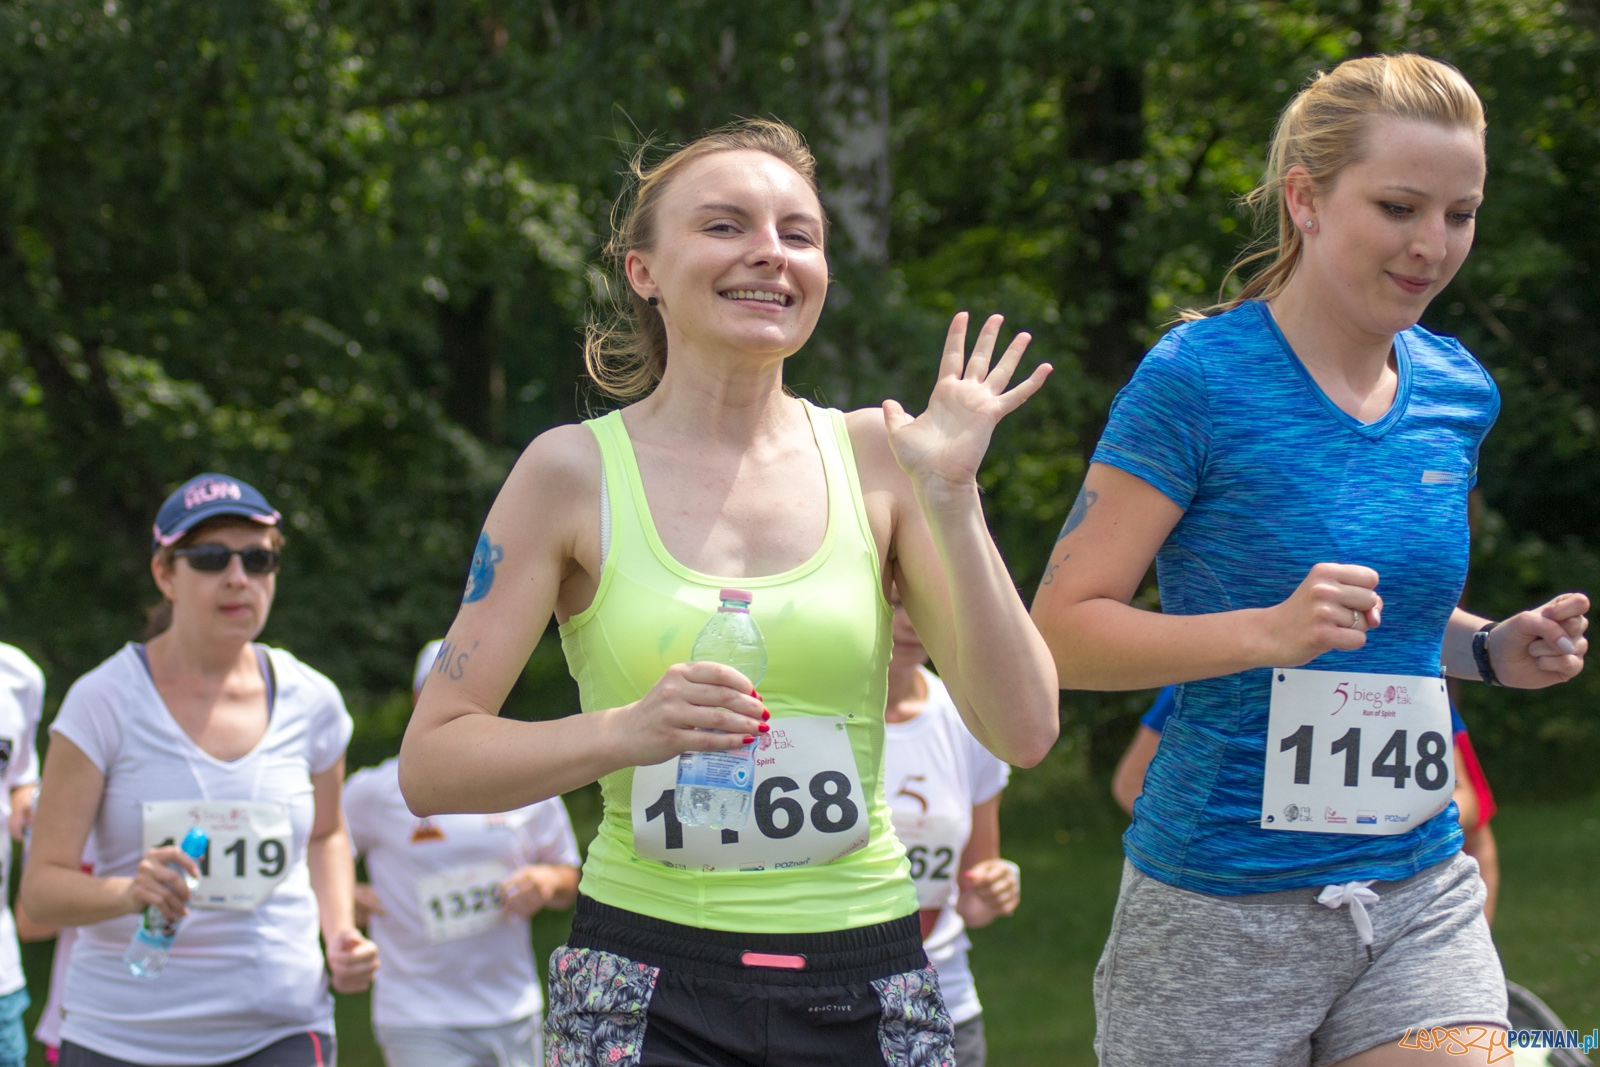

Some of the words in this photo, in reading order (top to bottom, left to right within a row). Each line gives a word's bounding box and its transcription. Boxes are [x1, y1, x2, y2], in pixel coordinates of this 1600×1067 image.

[1331, 682, 1349, 716] 5
[1353, 684, 1383, 709] bieg
[1397, 686, 1407, 694] na
[1397, 694, 1412, 705] tak
[772, 730, 786, 739] na
[774, 738, 795, 750] tak
[756, 757, 776, 767] Spirit
[1279, 725, 1449, 791] 1148
[645, 770, 859, 850] 168
